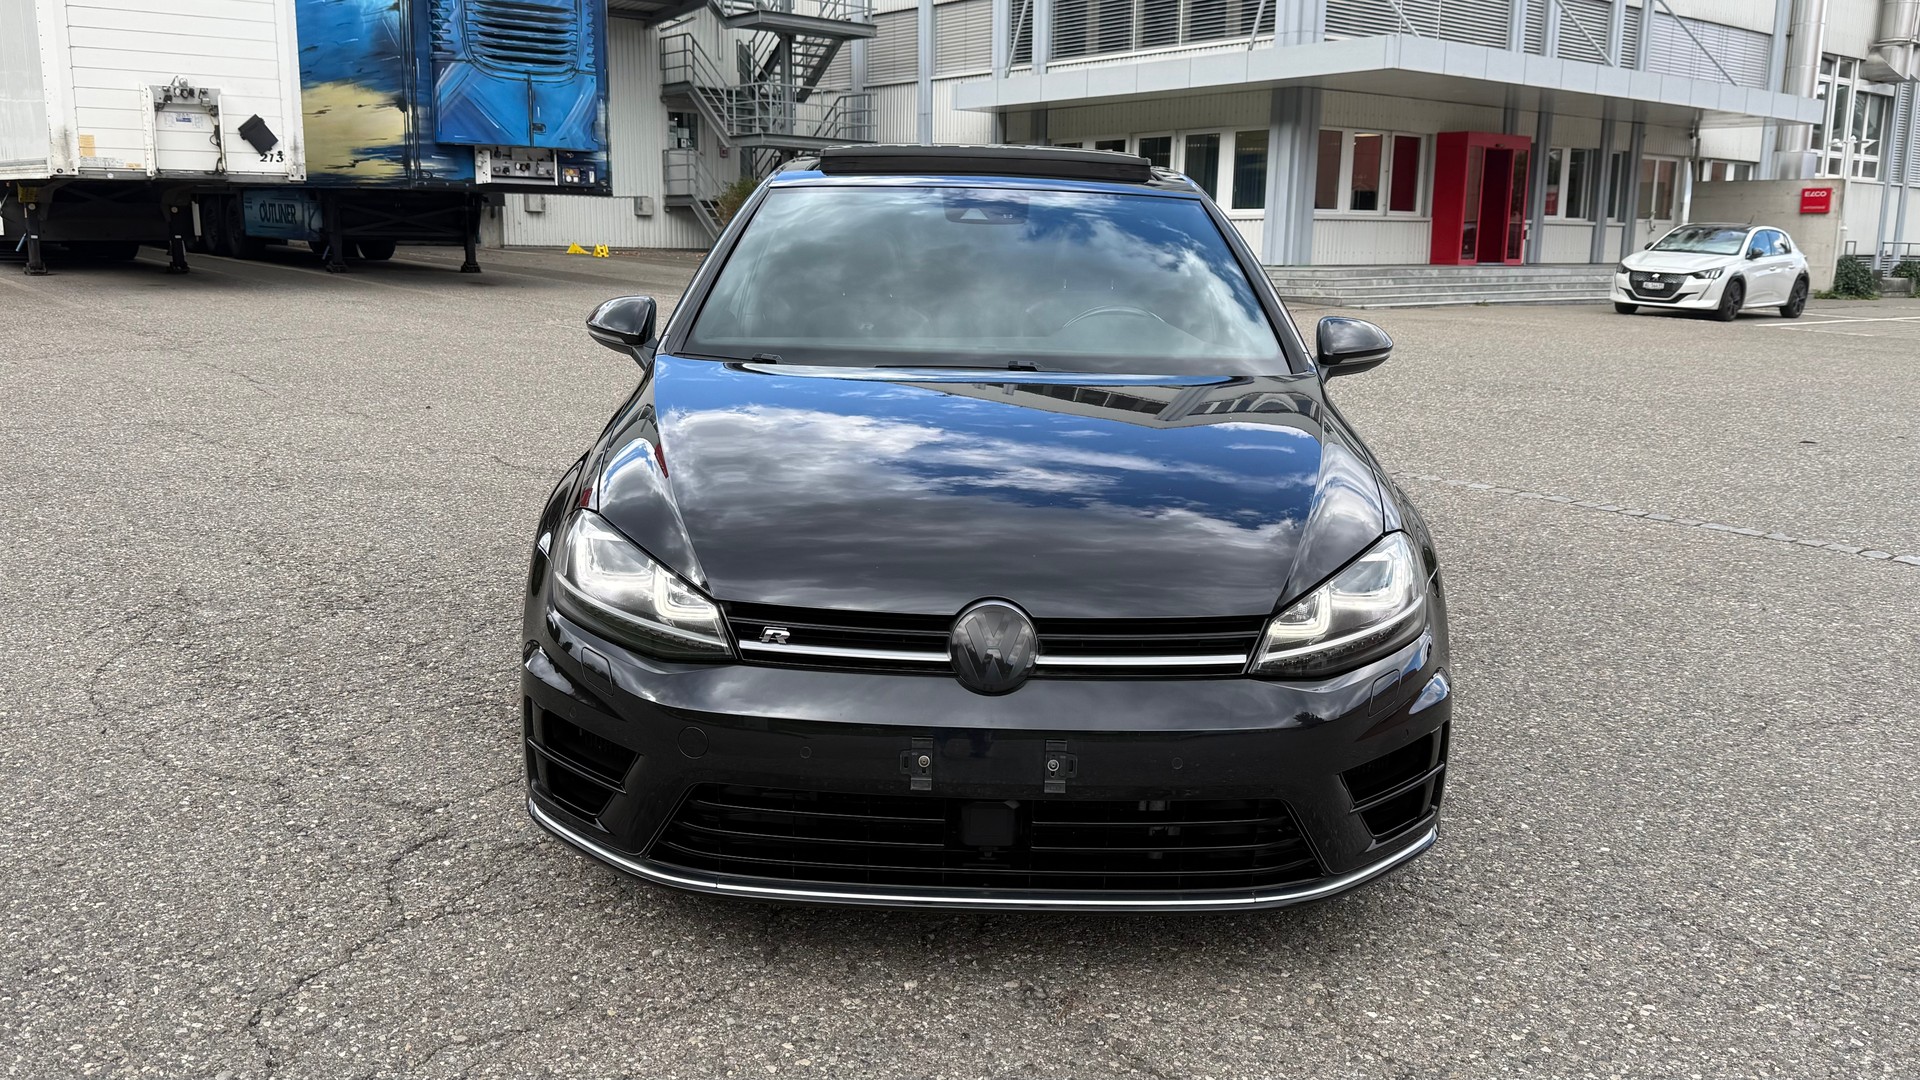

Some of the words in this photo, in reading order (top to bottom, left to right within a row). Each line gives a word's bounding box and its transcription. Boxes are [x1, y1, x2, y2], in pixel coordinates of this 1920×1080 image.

[259, 152, 284, 162] 213
[259, 200, 297, 225] OUTLINER
[760, 626, 790, 644] R
